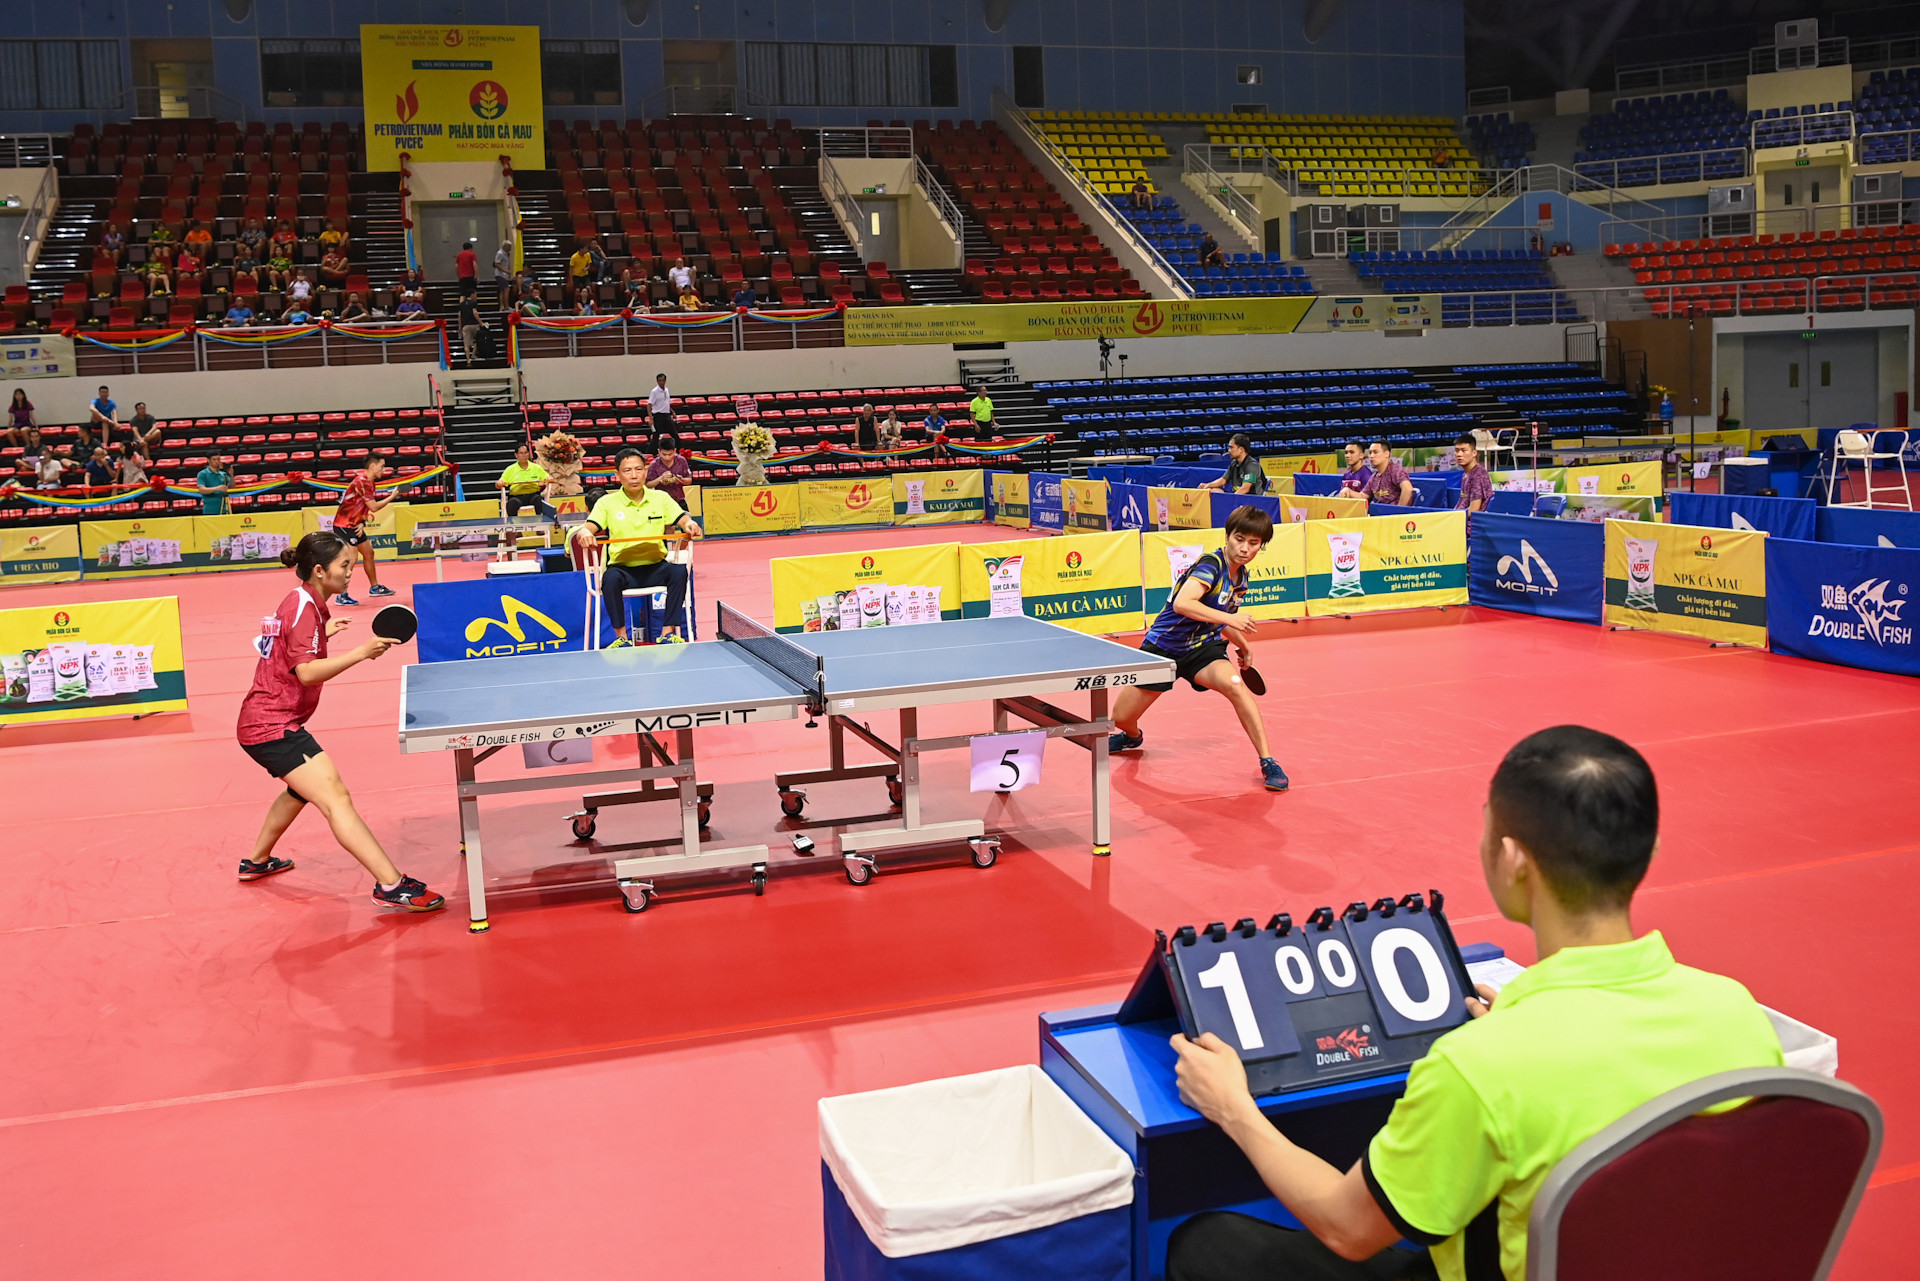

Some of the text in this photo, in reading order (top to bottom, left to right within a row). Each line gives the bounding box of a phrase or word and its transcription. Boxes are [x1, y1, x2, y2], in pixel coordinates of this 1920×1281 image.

[374, 124, 443, 136] PETROVIETNAM
[448, 122, 532, 139] PHÂN BÓN CÀ MAU
[396, 137, 424, 149] PVCFC
[1061, 304, 1081, 315] GIẢI
[1085, 304, 1098, 314] VÔ
[1100, 305, 1124, 314] ĐỊCH
[1028, 317, 1054, 326] BÓNG
[1058, 316, 1077, 326] BÀN
[1080, 315, 1107, 326] QUỐC
[1172, 312, 1244, 322] PETROVIETNAM
[1808, 316, 1814, 328] 1
[1054, 324, 1125, 336] BÁO NHÂN DÂN
[1172, 324, 1201, 333] PVCFC
[1700, 467, 1706, 478] 6
[849, 484, 868, 502] 41
[754, 490, 772, 510] 41
[494, 526, 536, 534] MOFIT
[383, 537, 396, 546] MA
[1336, 554, 1355, 564] NPK
[1380, 552, 1445, 568] NPK CÀ MAU
[14, 562, 60, 572] UREA BIO
[1264, 565, 1290, 577] MAU
[1632, 563, 1650, 572] NPK
[1384, 572, 1400, 582] Chất
[1400, 573, 1420, 584] lượng
[1674, 572, 1742, 590] NPK CÀ MAU
[1496, 579, 1558, 597] MOFIT
[864, 600, 881, 610] NPK
[1034, 601, 1068, 618] ĐẠM
[1072, 596, 1092, 612] CÀ
[1094, 594, 1128, 611] MAU
[1676, 594, 1692, 603] Chất
[1693, 596, 1714, 608] lượng
[1714, 598, 1722, 607] đi
[1808, 614, 1912, 645] DOUBLE FISH
[466, 638, 568, 658] MOFIT
[60, 660, 79, 670] NPK
[1074, 674, 1137, 690] 双鱼 235
[636, 708, 757, 732] MOFIT
[476, 734, 517, 746] DOUBLE
[520, 732, 541, 742] FISH
[999, 749, 1020, 788] 5
[1198, 928, 1450, 1050] 1 0 0 0
[1316, 1046, 1379, 1066] DOUBLE FISH
